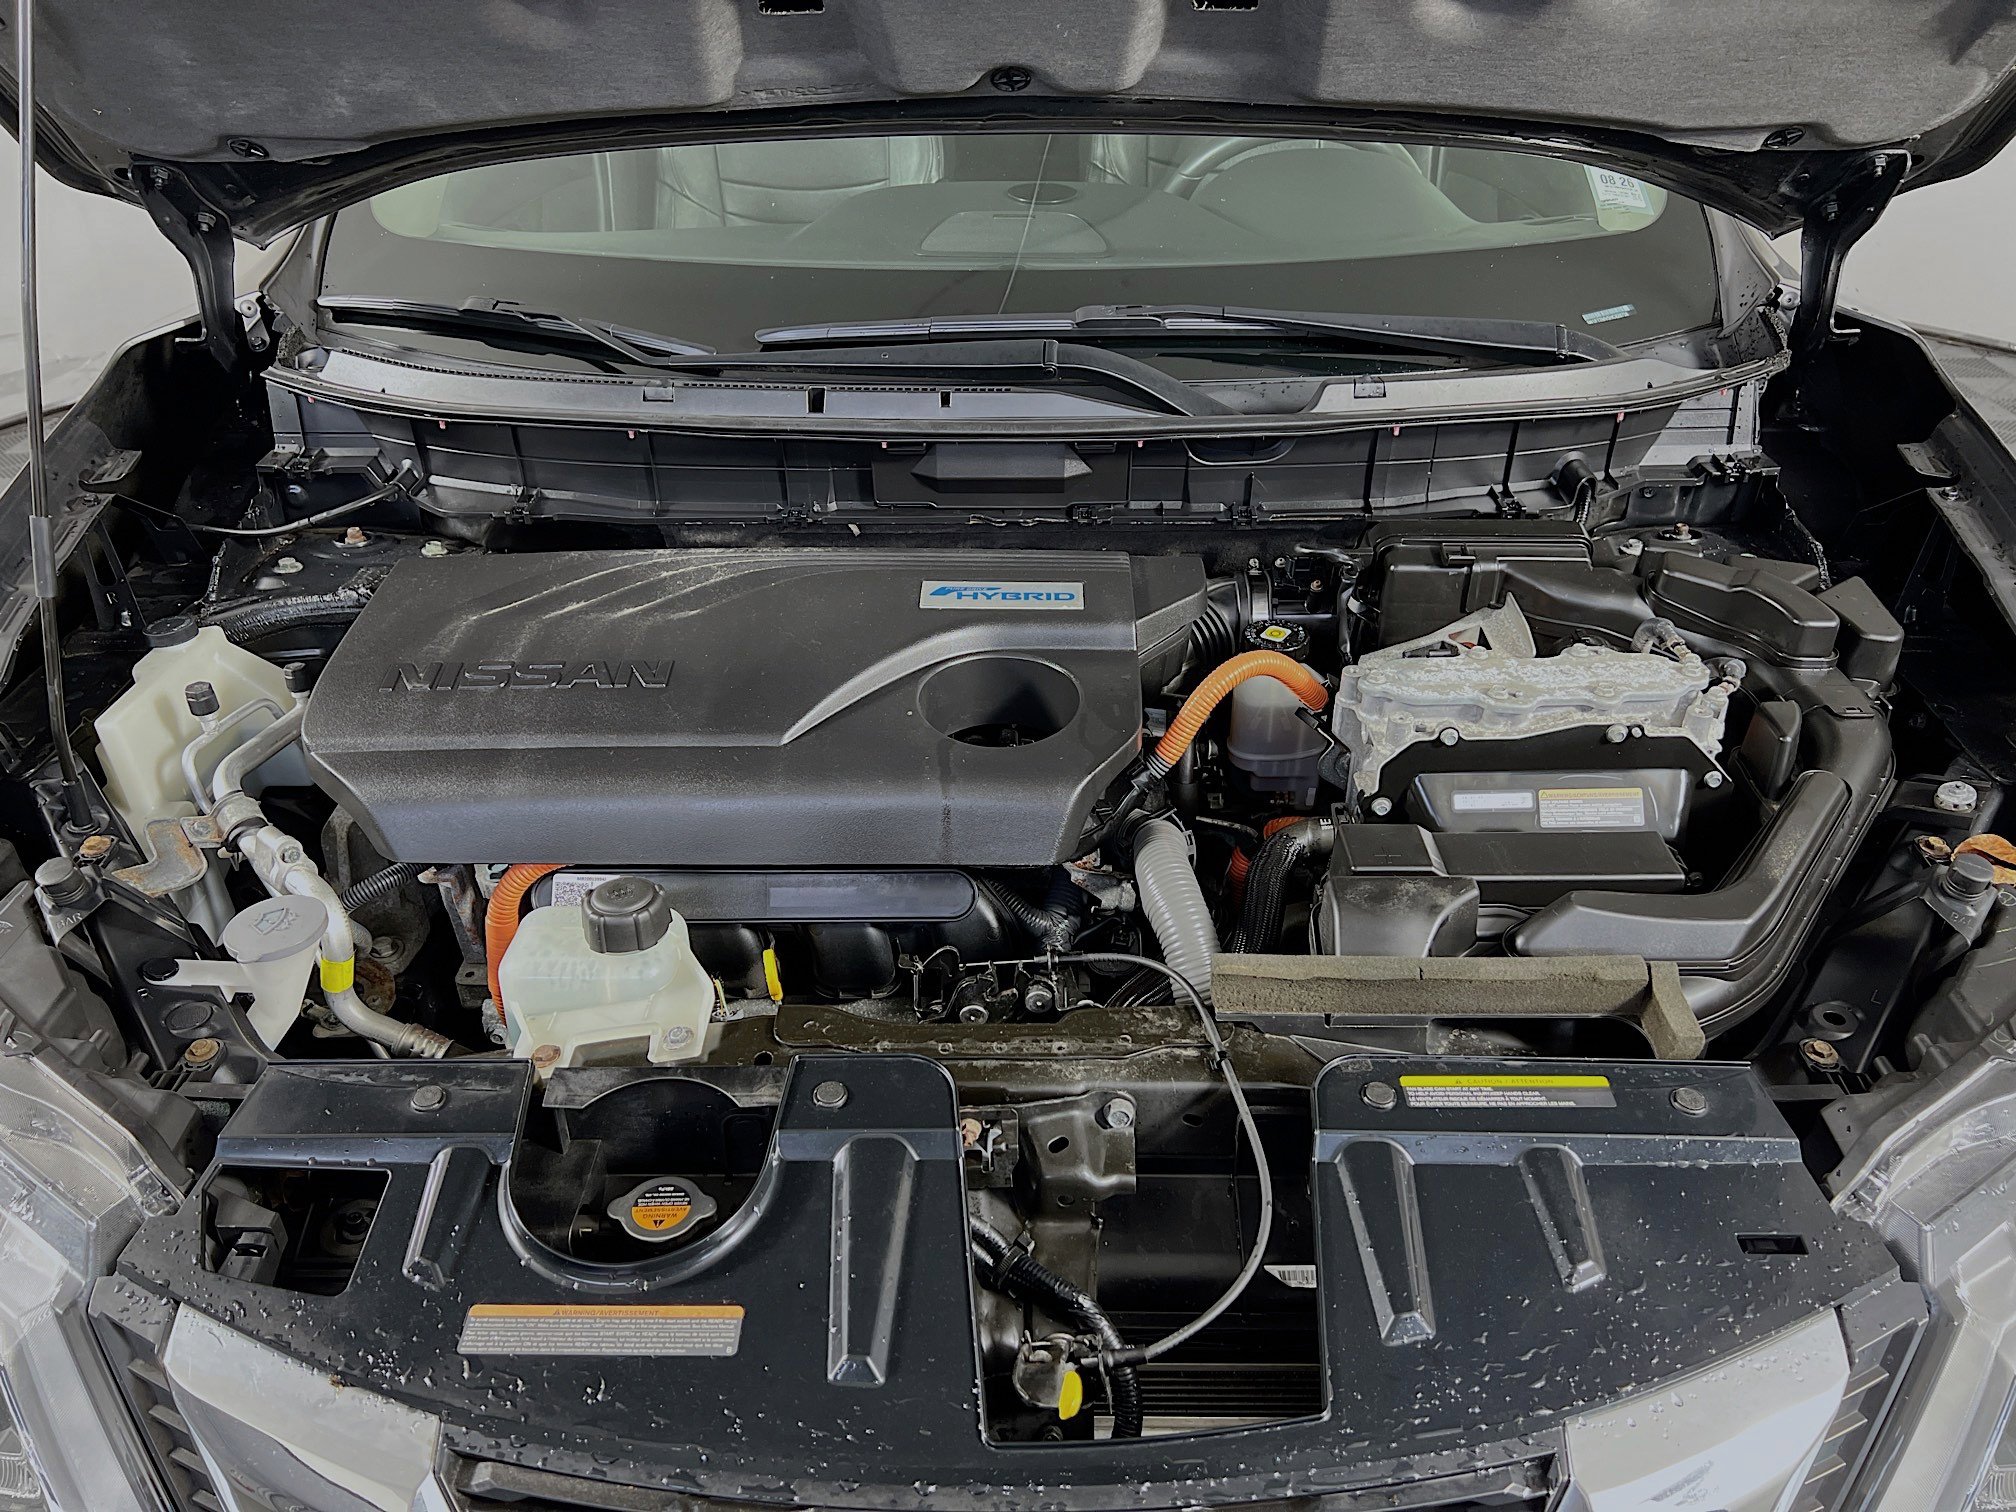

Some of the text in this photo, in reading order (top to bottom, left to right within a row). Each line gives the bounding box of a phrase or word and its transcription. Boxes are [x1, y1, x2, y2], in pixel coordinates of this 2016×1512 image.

[1600, 173, 1635, 188] 08 26
[956, 592, 1075, 601] HYBRID
[379, 660, 675, 692] NISSAN
